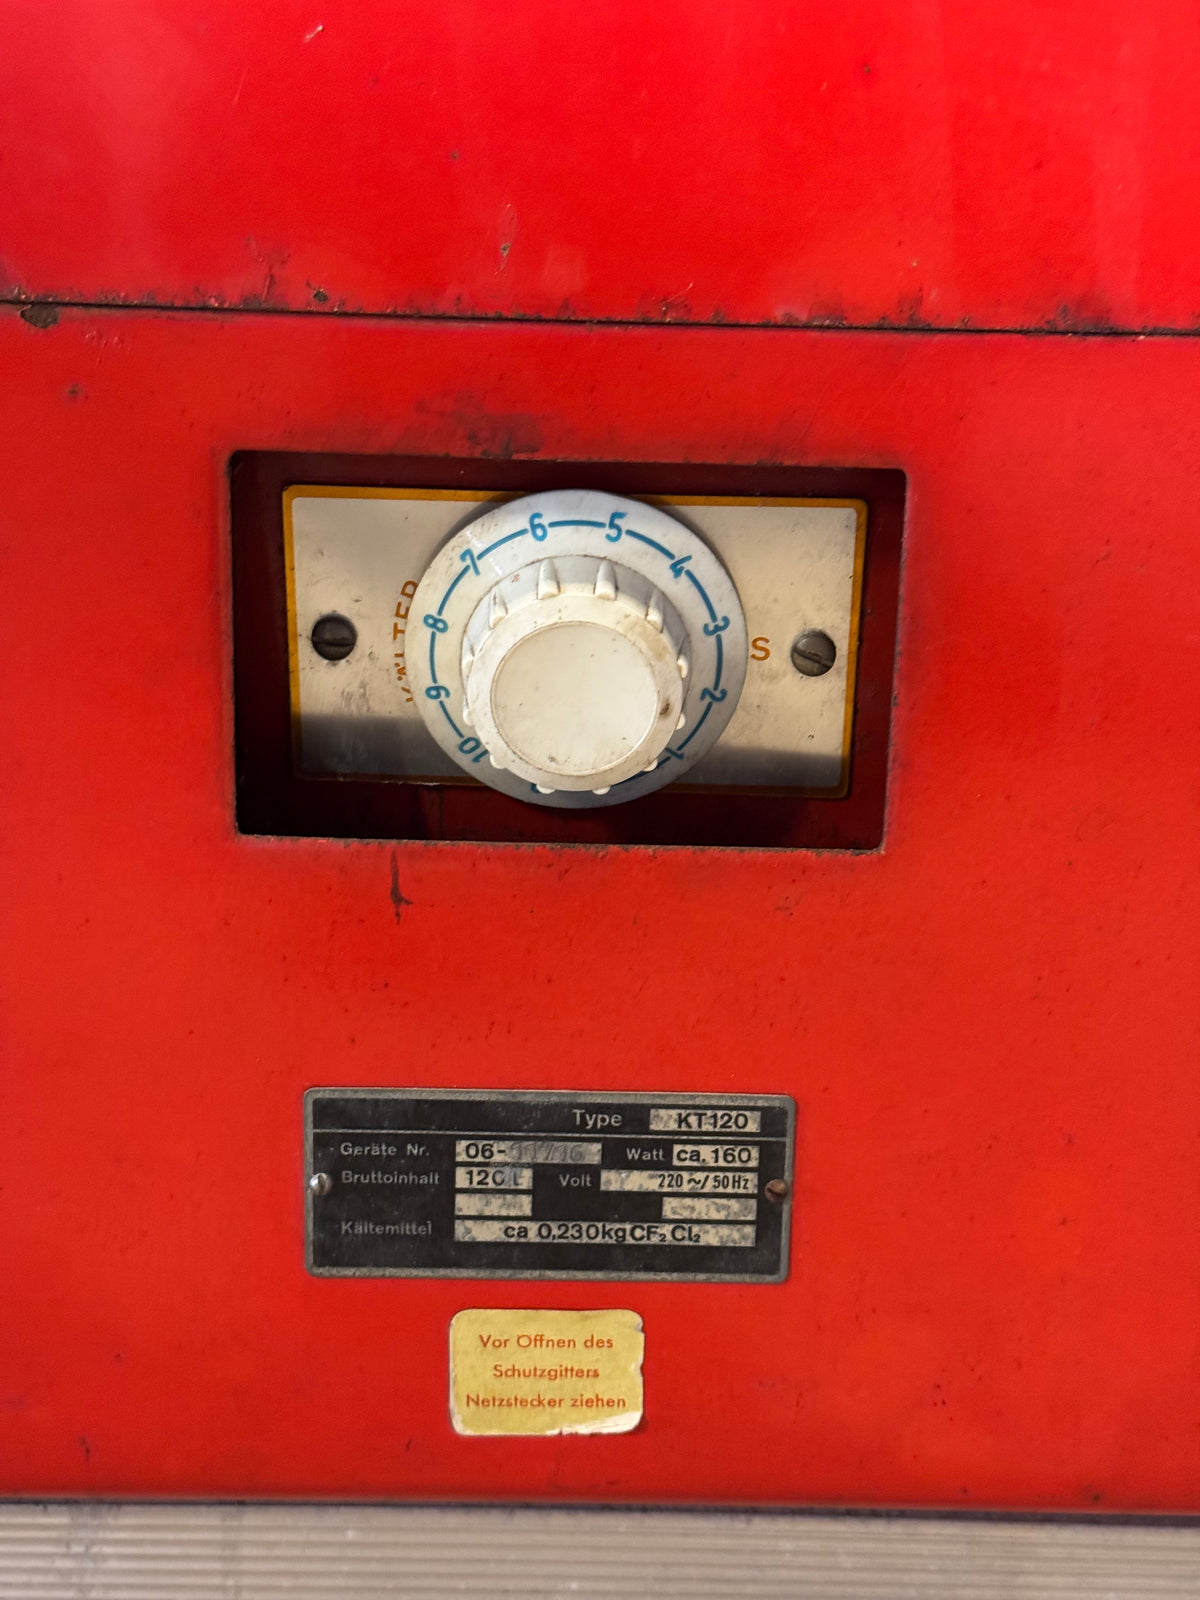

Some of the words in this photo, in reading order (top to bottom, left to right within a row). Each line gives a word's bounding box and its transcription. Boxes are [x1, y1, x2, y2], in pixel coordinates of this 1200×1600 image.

[529, 512, 548, 542] 6
[605, 511, 627, 543] 5
[460, 549, 480, 576] 7
[670, 555, 692, 579] 4
[423, 614, 449, 633] 8
[703, 616, 730, 636] 3
[750, 636, 771, 661] S
[425, 685, 450, 700] 9
[700, 687, 728, 703] 2
[458, 736, 489, 763] 10
[572, 1109, 623, 1130] Type
[677, 1112, 748, 1130] KT120
[340, 1142, 397, 1156] Geräte
[406, 1143, 430, 1157] Nr.
[626, 1148, 664, 1161] Watt
[714, 1148, 752, 1164] 160
[341, 1170, 440, 1186] Bruttoinhalt
[559, 1173, 592, 1187] Volt
[341, 1220, 433, 1236] Kältemittel
[503, 1226, 529, 1239] ca
[479, 1333, 510, 1348] Vor
[517, 1333, 577, 1348] Öffnen
[584, 1334, 613, 1349] des
[493, 1363, 600, 1381] Schutzgitters
[466, 1393, 564, 1408] Netzstecker
[571, 1394, 627, 1408] ziehen
